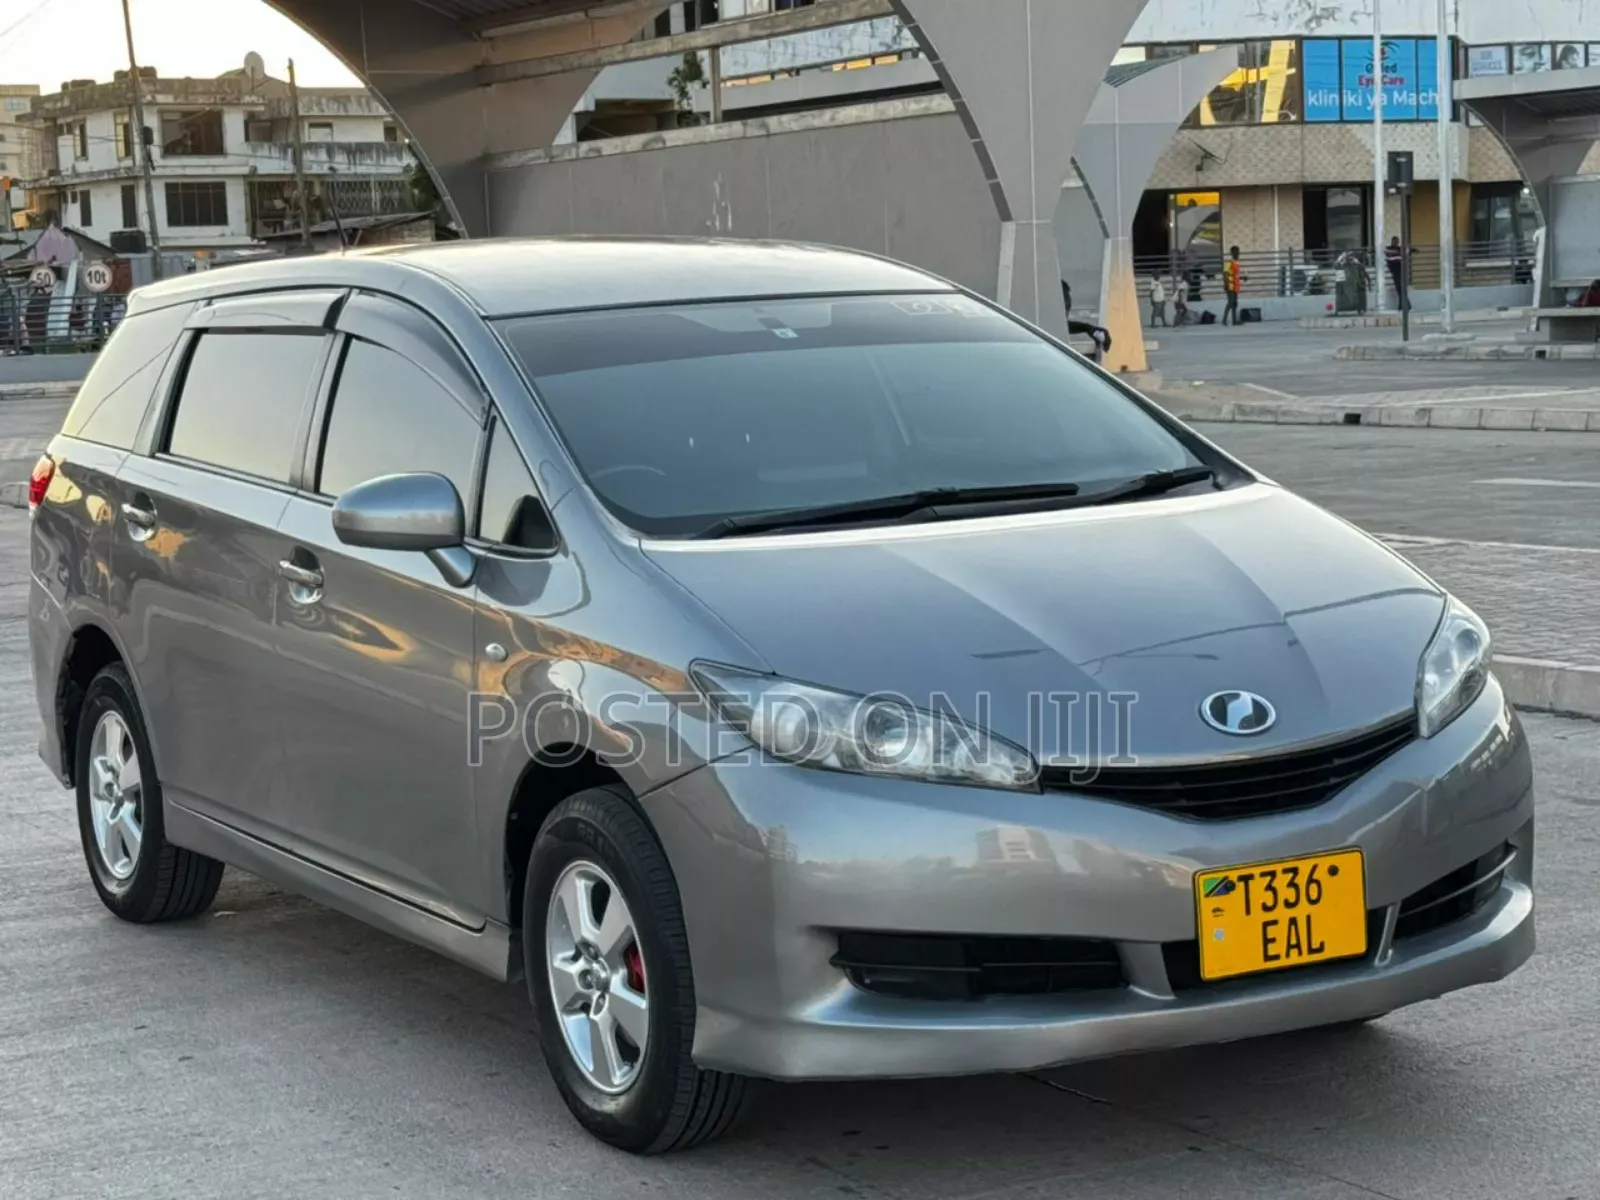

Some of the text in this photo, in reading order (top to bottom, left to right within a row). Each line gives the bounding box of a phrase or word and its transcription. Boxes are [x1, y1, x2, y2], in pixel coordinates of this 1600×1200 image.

[1380, 75, 1405, 86] Care
[1308, 89, 1362, 107] kliniki
[1366, 92, 1388, 111] ya
[35, 272, 52, 286] 50
[87, 270, 107, 285] 10t
[1237, 863, 1323, 916] T336
[1261, 913, 1326, 963] EAL
